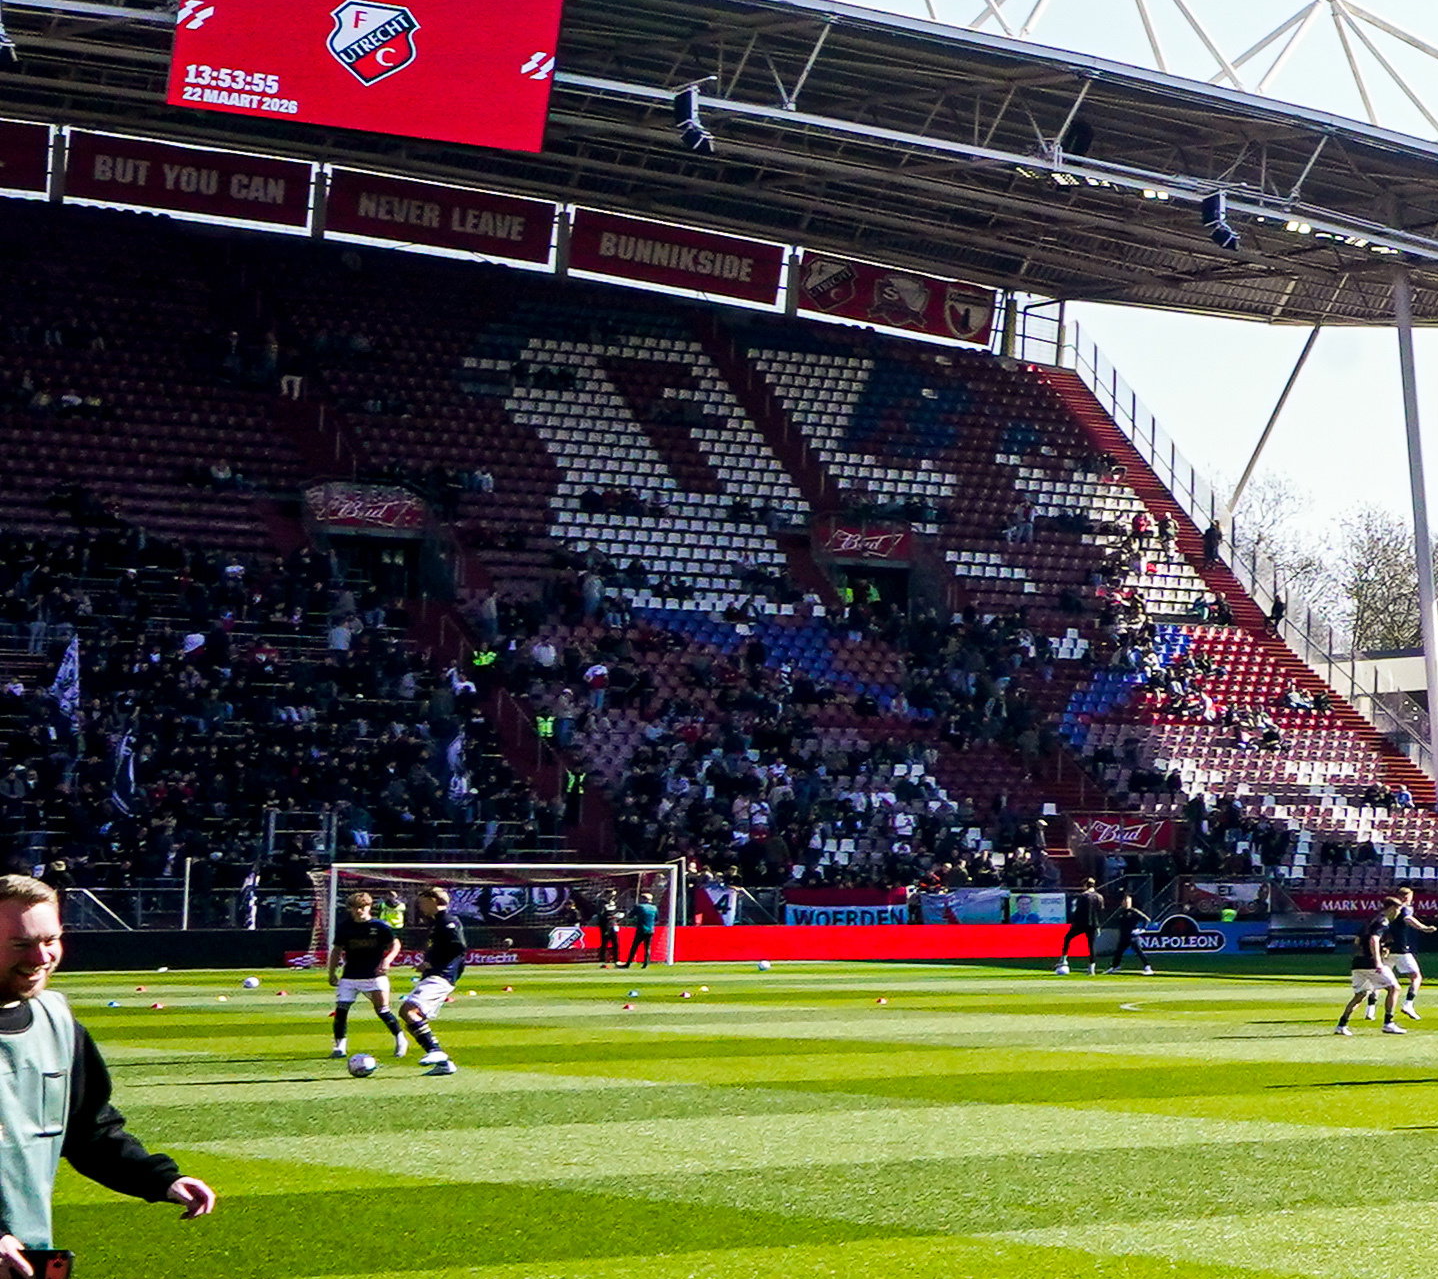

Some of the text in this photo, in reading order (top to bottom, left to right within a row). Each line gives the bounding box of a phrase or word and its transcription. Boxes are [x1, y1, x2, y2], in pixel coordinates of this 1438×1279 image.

[353, 10, 368, 29] F
[340, 14, 410, 64] UTRECHT
[375, 48, 396, 68] C
[184, 64, 279, 95] 13:53:55
[182, 87, 298, 115] 22 MAART 2026
[94, 154, 286, 206] BUT YOU CAN
[357, 192, 527, 242] NEVER LEAVE
[599, 231, 754, 283] BUNNIKSIDE
[1094, 823, 1144, 842] Bud
[792, 908, 904, 926] WOERDEN
[1321, 900, 1358, 911] MARK
[1139, 934, 1220, 950] NAPOLEON
